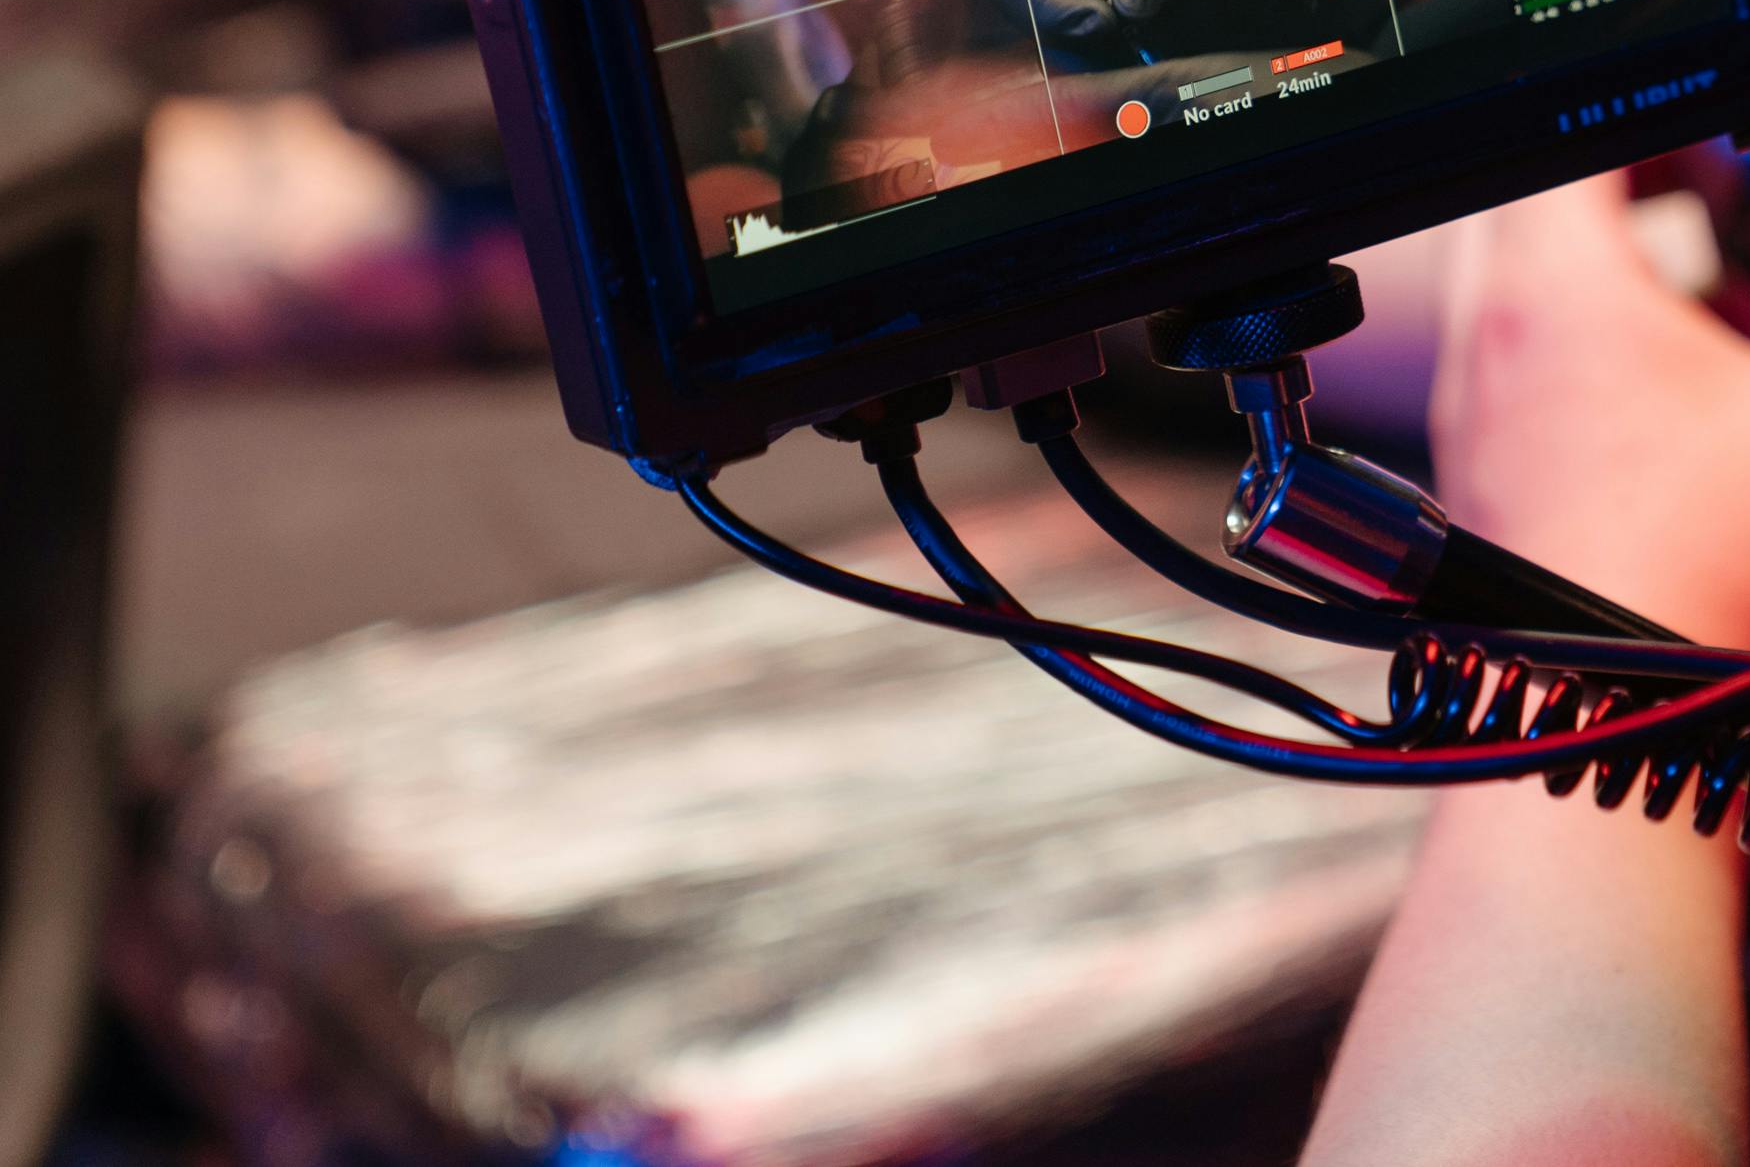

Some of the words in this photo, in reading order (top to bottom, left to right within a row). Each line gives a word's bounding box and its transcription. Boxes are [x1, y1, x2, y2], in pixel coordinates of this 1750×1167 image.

[1303, 47, 1328, 63] A002
[1277, 71, 1332, 99] 24min
[1183, 107, 1210, 126] No
[1214, 92, 1253, 118] card
